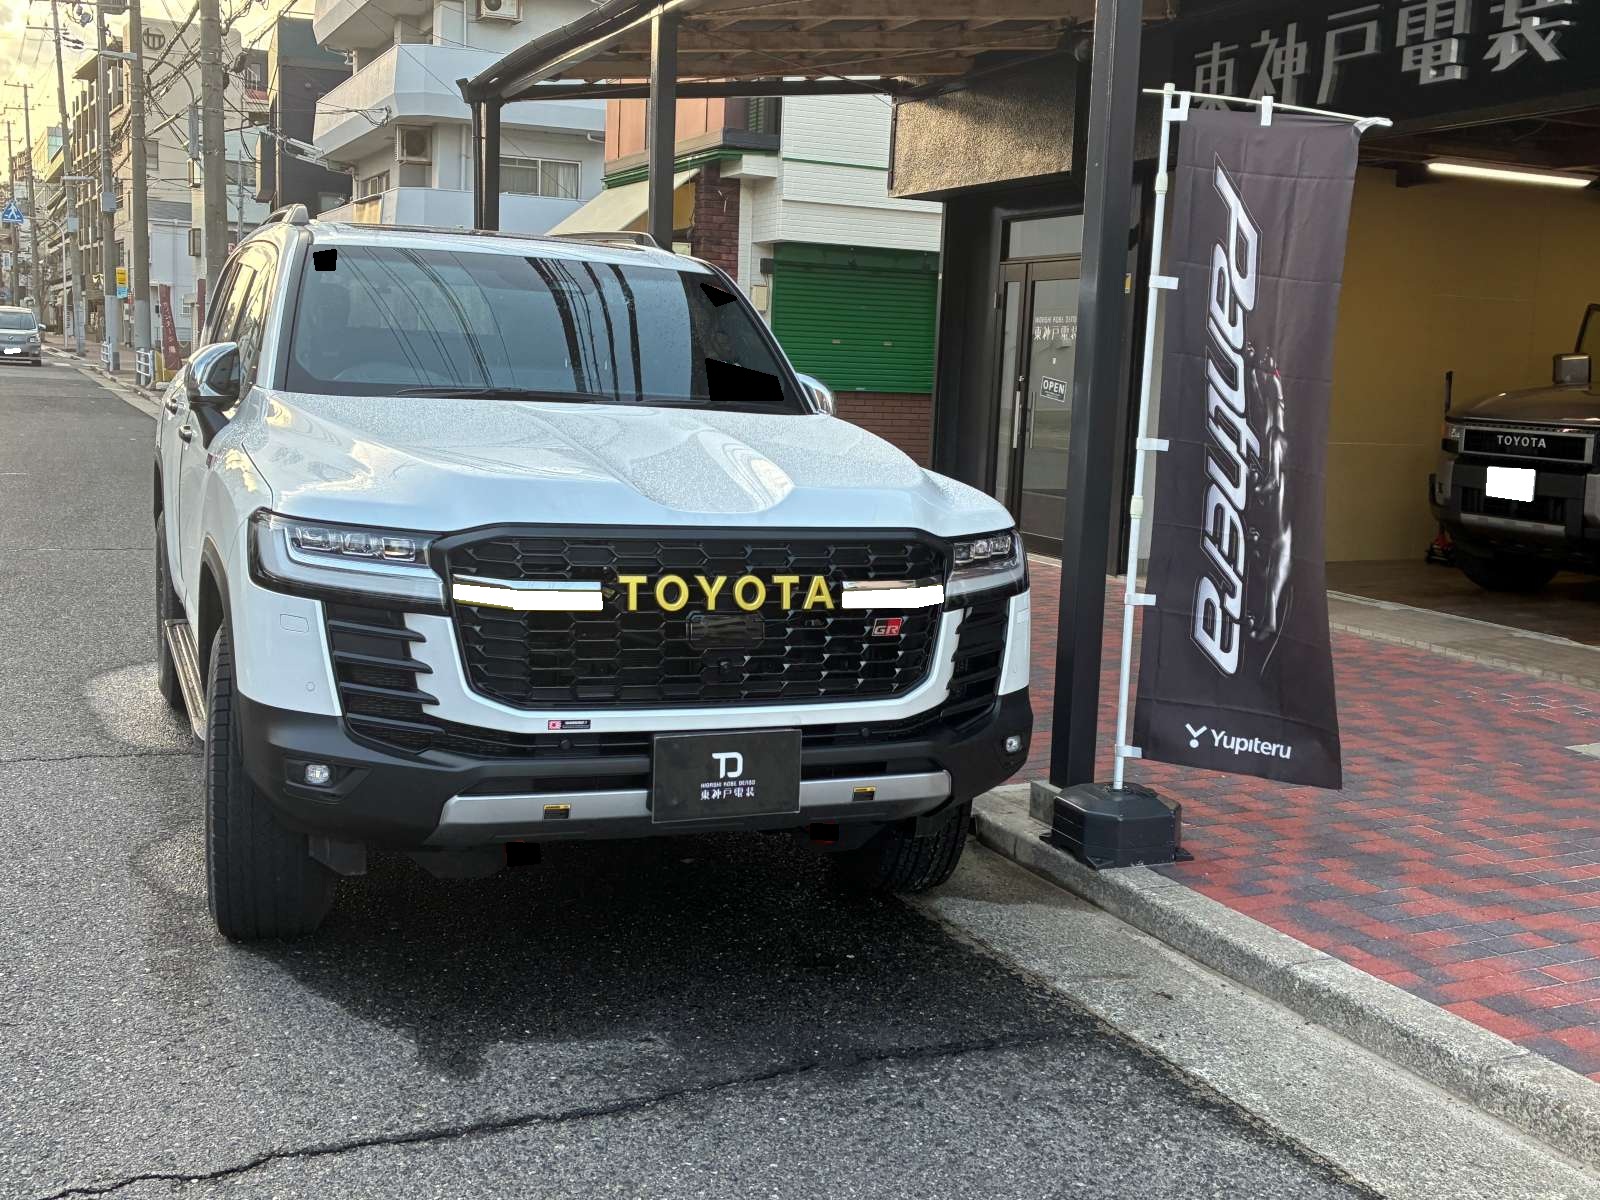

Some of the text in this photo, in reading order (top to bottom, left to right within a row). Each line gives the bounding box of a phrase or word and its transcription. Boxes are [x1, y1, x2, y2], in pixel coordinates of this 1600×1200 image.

[1043, 379, 1065, 394] OPEN
[1496, 434, 1547, 448] TOYOTA
[618, 575, 835, 612] TOYOTA
[873, 624, 900, 636] GR
[1211, 728, 1292, 759] Yupiteru
